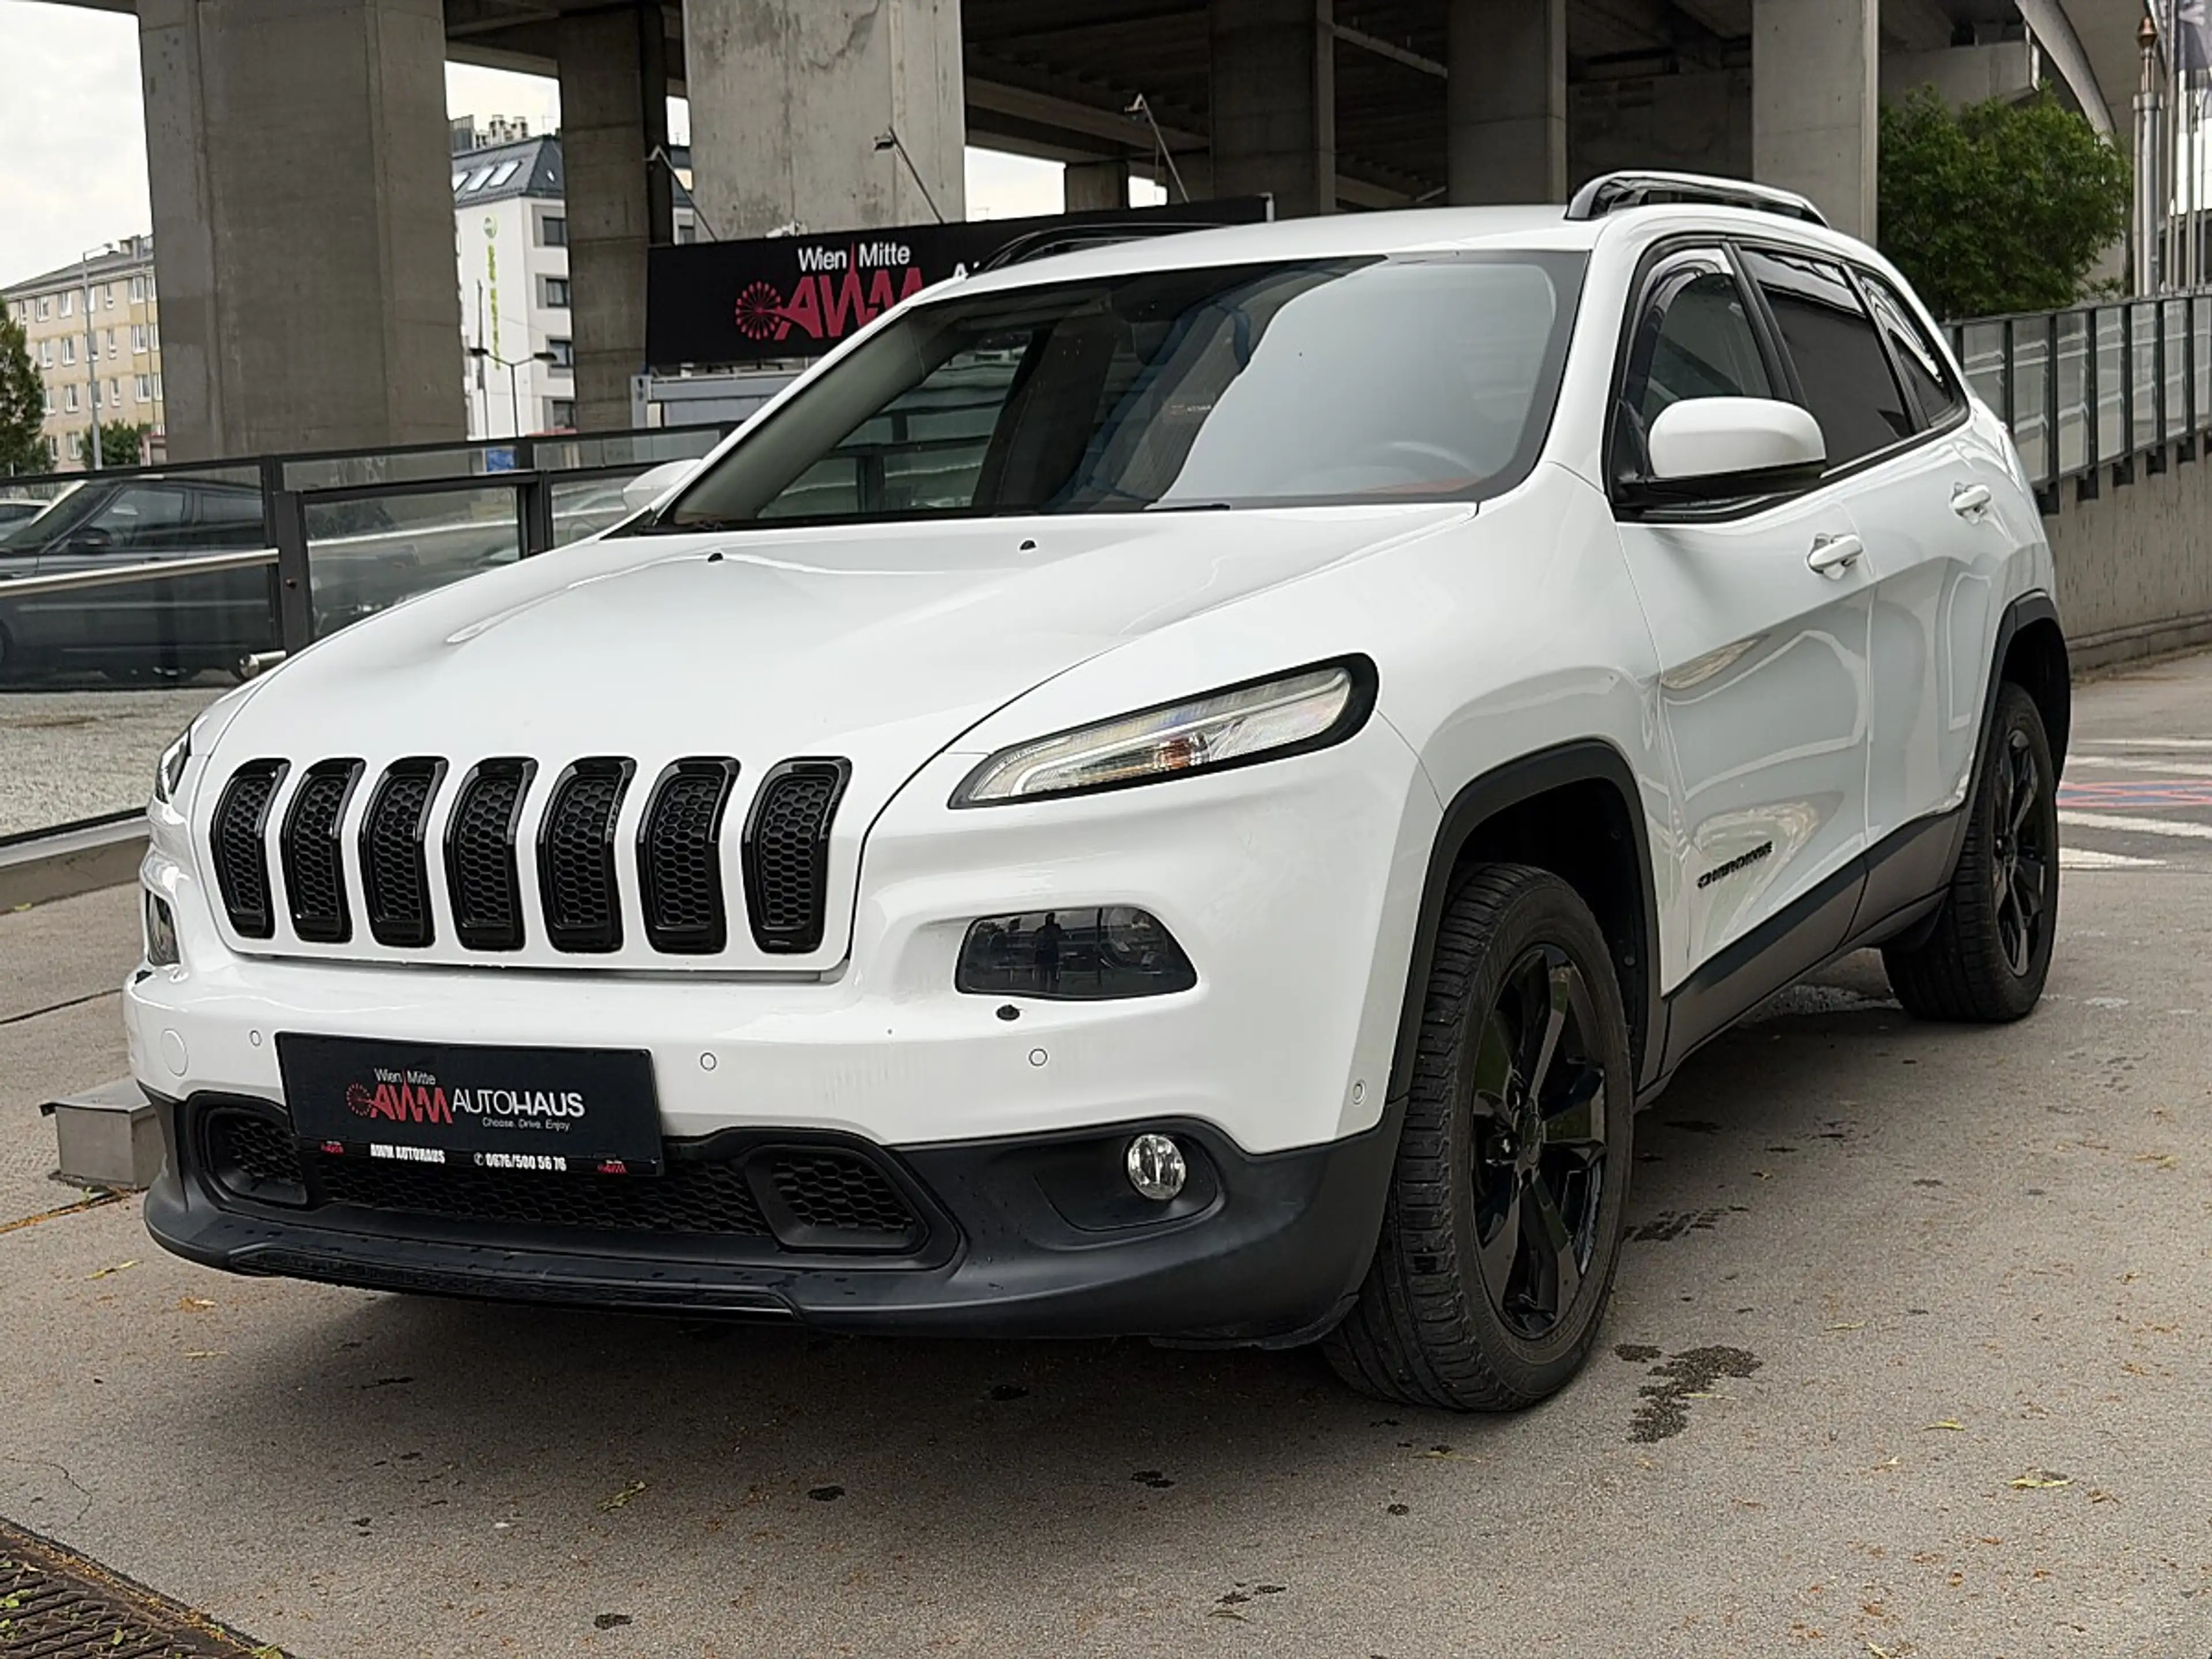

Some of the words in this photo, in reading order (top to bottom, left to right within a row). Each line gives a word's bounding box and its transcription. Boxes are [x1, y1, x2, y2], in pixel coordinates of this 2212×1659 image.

[798, 247, 846, 272] Wien
[859, 244, 911, 267] Mitte
[374, 1068, 402, 1083] Wien
[407, 1070, 436, 1085] Mitte
[452, 1088, 585, 1118] AUTOHAUS
